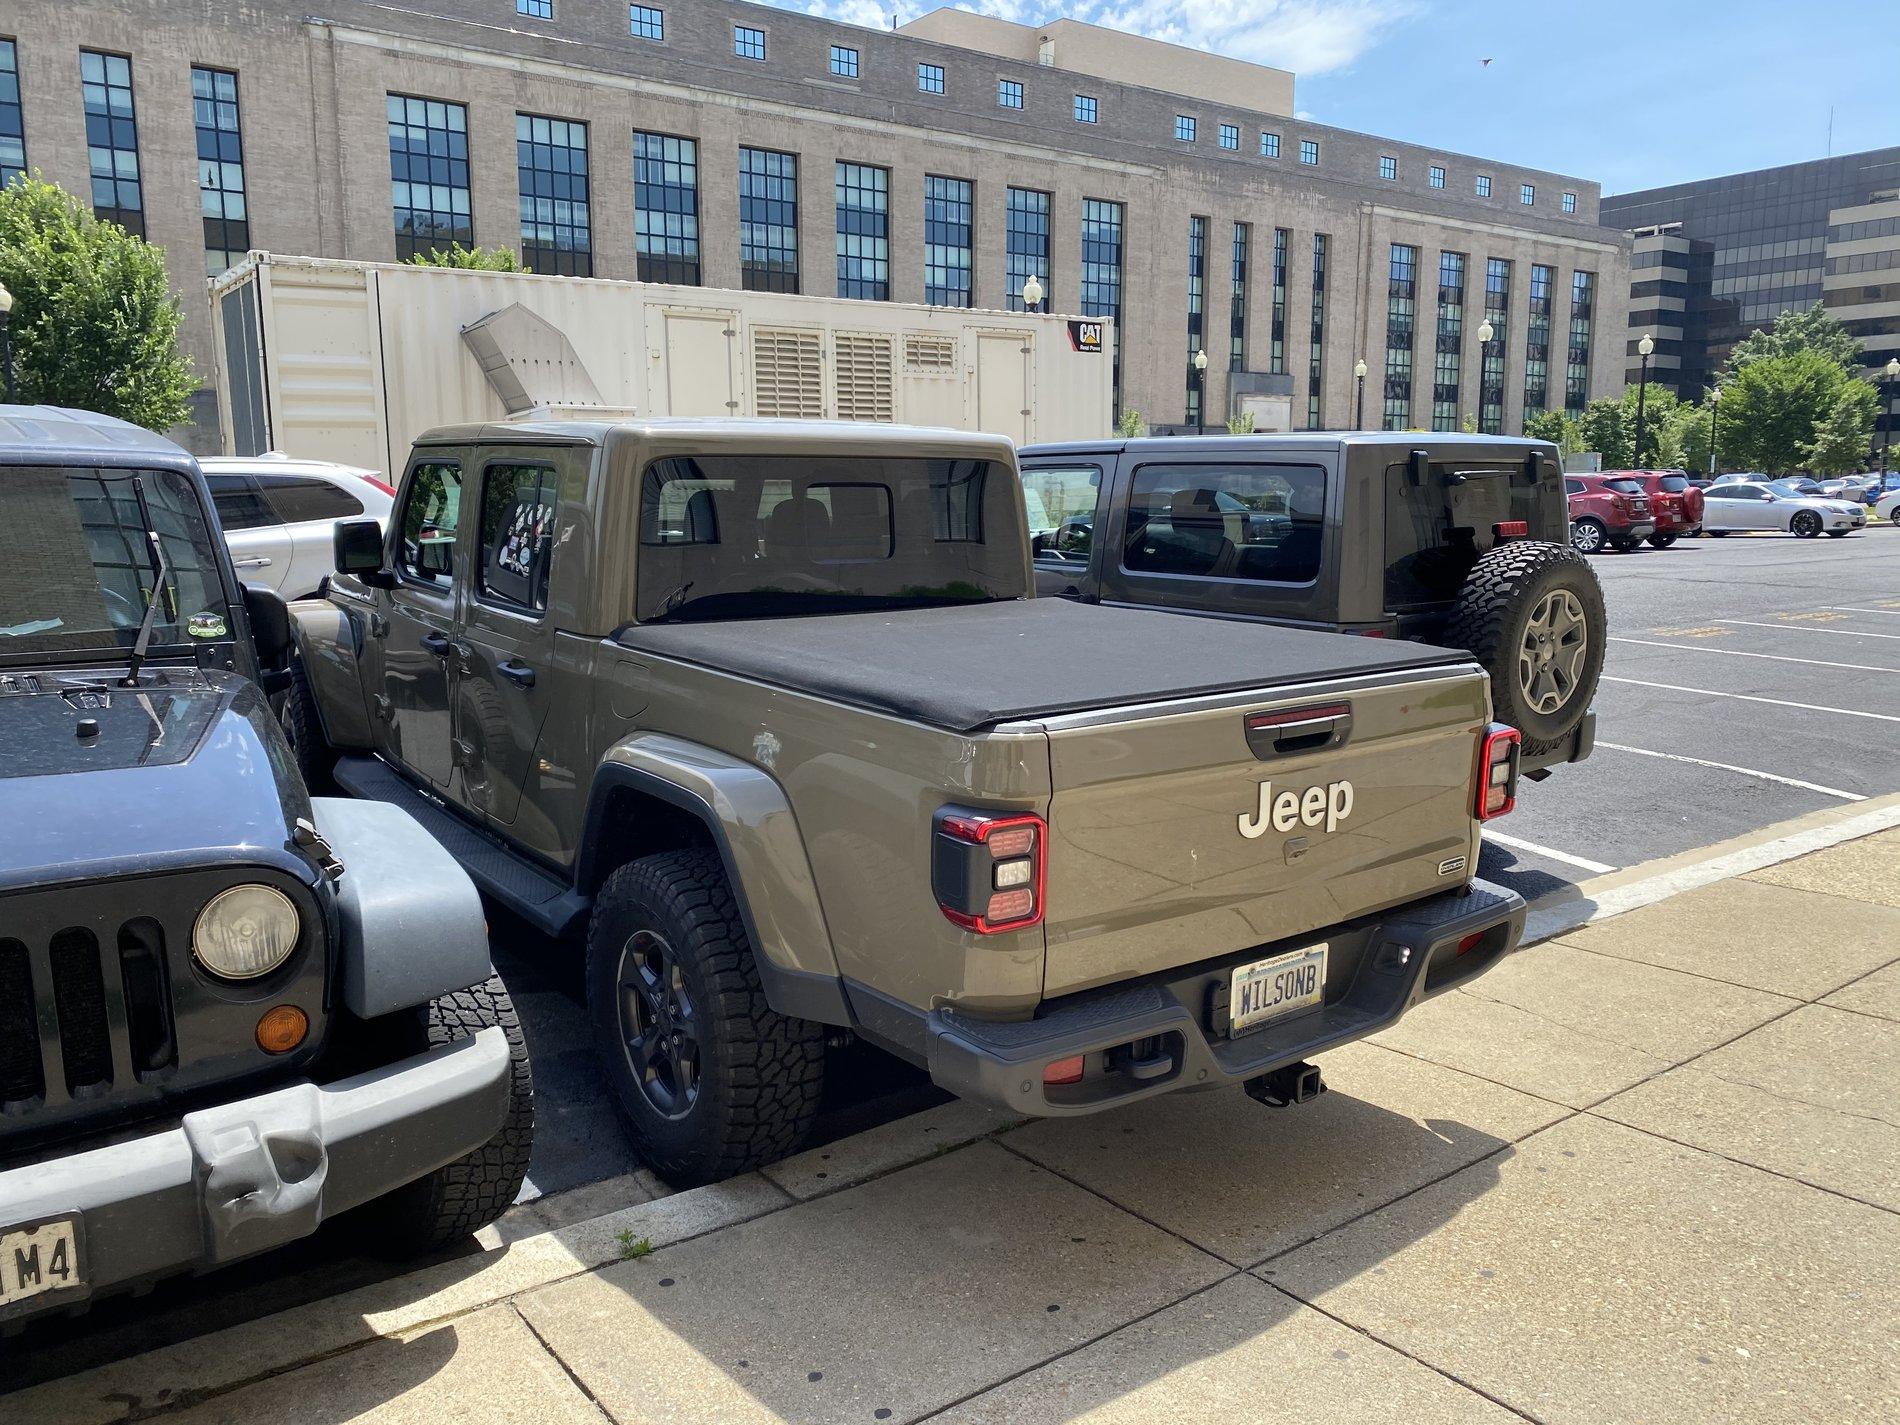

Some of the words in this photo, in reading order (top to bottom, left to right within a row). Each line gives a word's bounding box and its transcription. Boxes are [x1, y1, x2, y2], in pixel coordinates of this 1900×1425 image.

[1080, 323, 1102, 344] CAT
[1237, 779, 1354, 839] Jeep
[1241, 964, 1317, 1017] WILSONB
